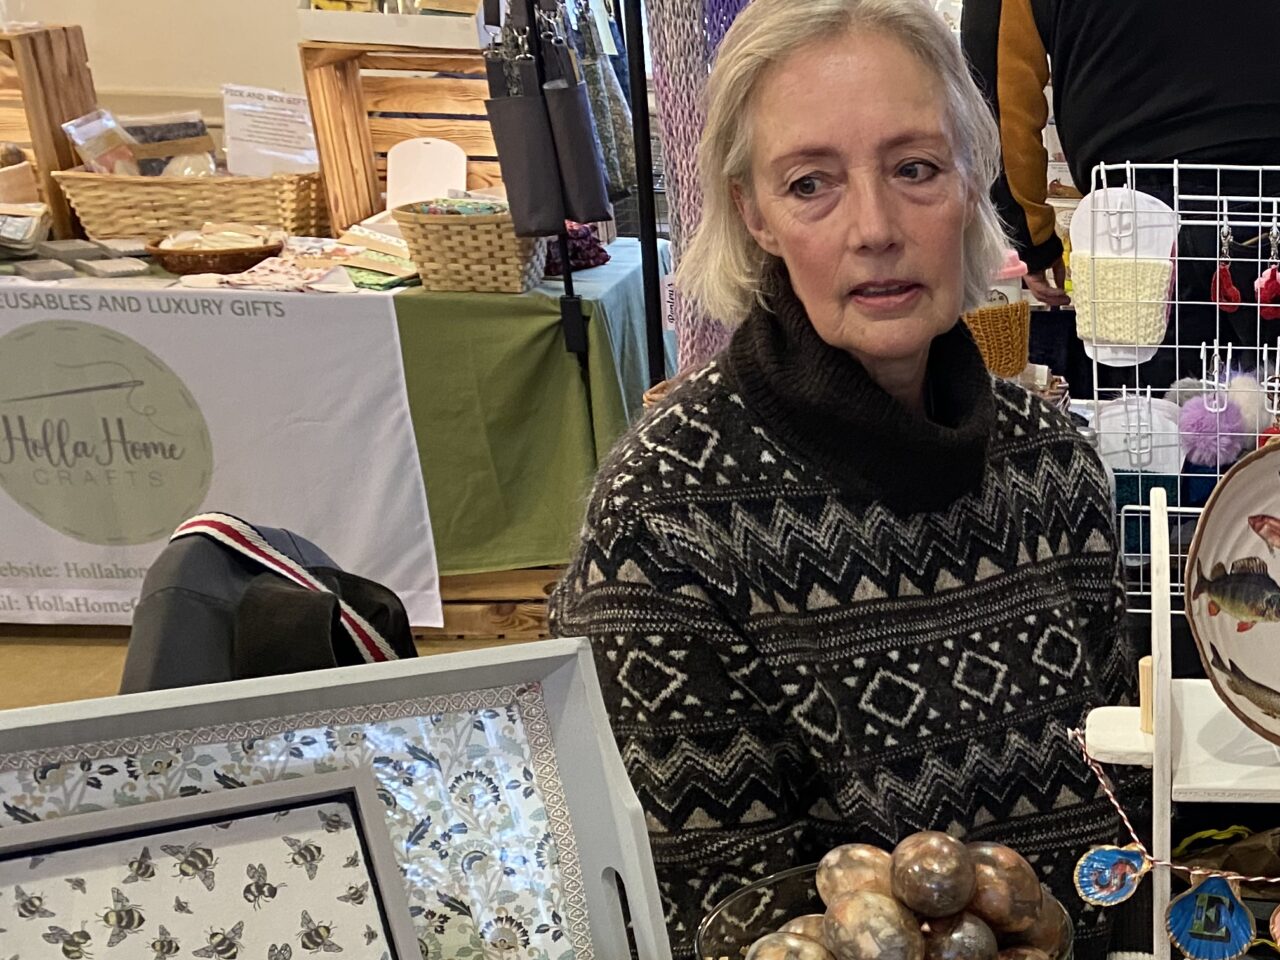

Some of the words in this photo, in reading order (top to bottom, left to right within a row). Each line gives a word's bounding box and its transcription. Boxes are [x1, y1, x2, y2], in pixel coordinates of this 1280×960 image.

[99, 295, 141, 313] AND
[149, 297, 223, 315] LUXURY
[231, 300, 286, 318] GIFTS
[33, 468, 165, 488] CRAFTS
